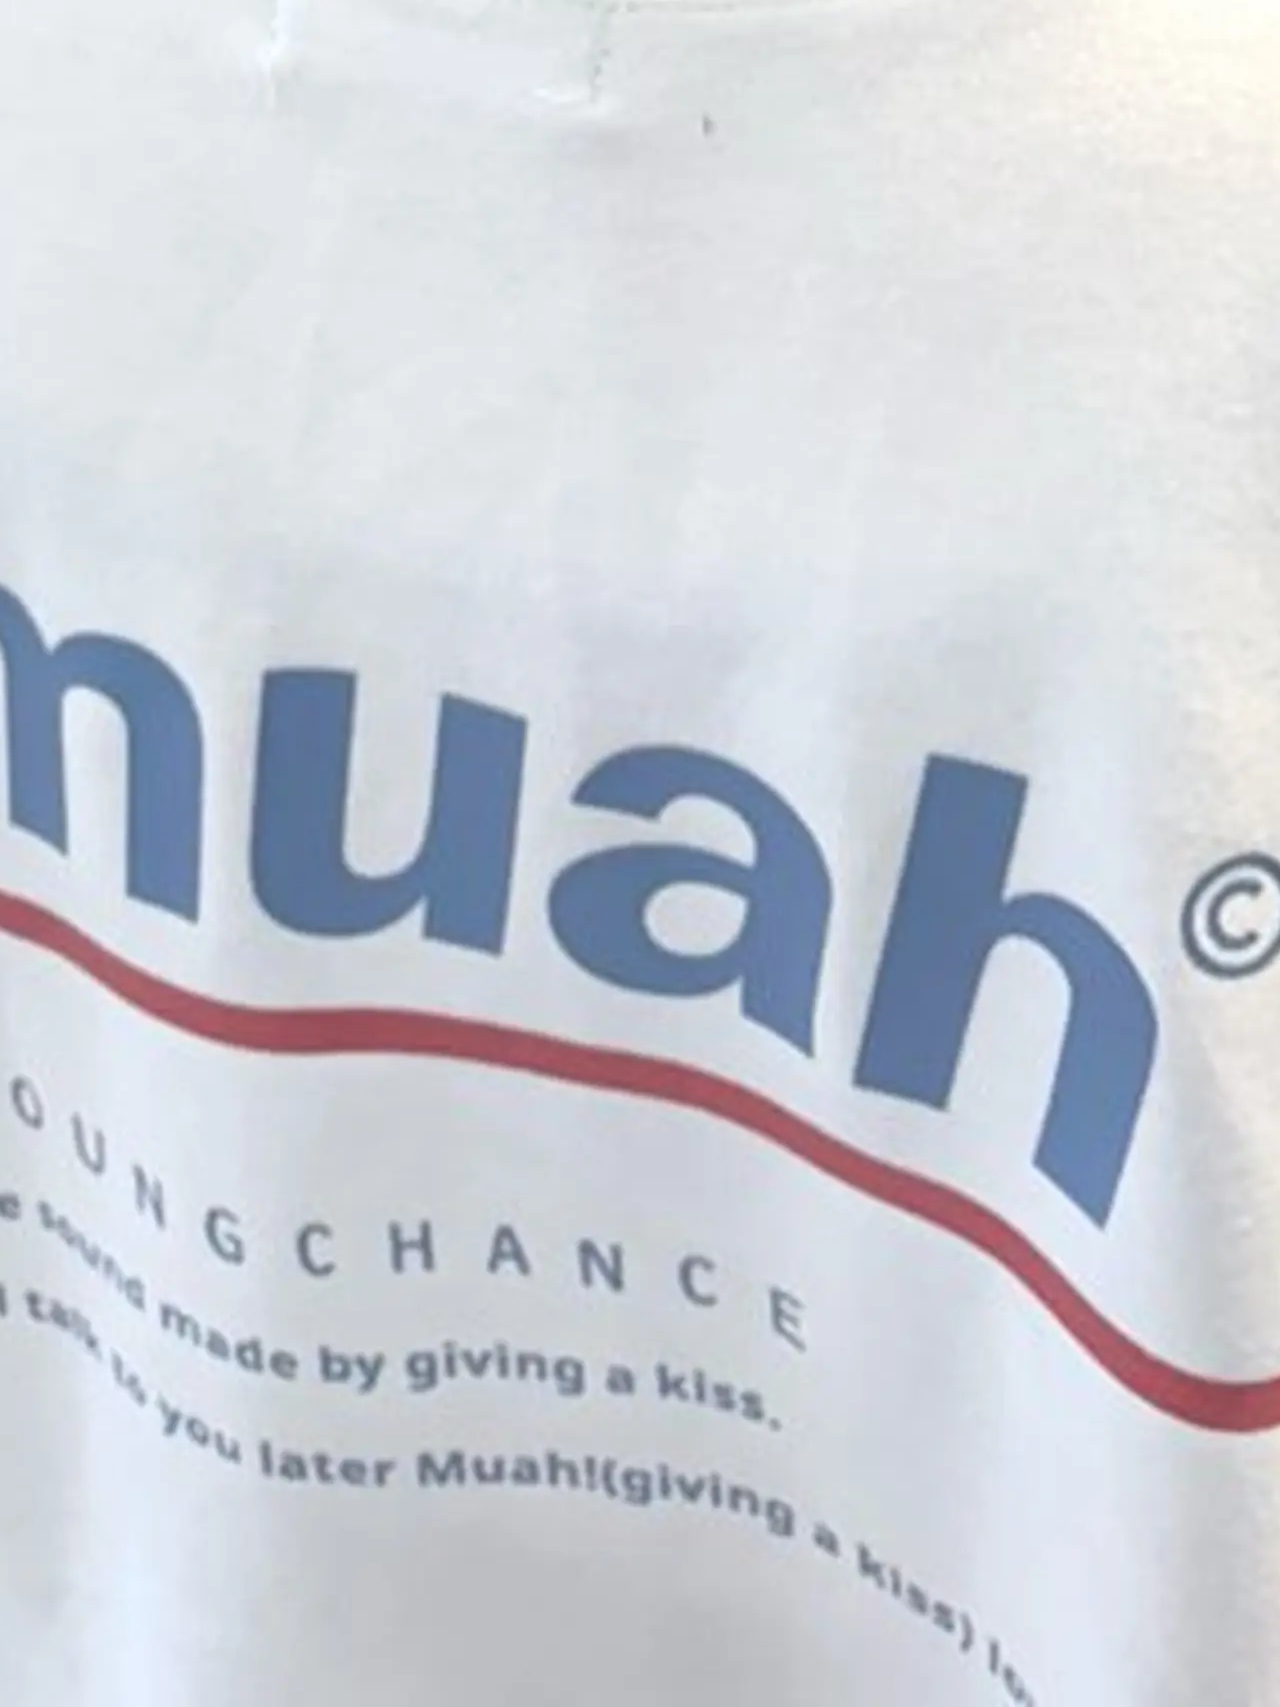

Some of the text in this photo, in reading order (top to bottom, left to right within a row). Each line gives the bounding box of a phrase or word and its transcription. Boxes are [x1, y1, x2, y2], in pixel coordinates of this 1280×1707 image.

[160, 1300, 298, 1380] made
[321, 1346, 385, 1394] by
[405, 1340, 586, 1397] giving
[605, 1363, 636, 1395] a
[657, 1364, 783, 1431] kiss.
[160, 1395, 240, 1464] you
[260, 1439, 397, 1486] later
[813, 1521, 841, 1558] a
[856, 1542, 974, 1653] kiss)
